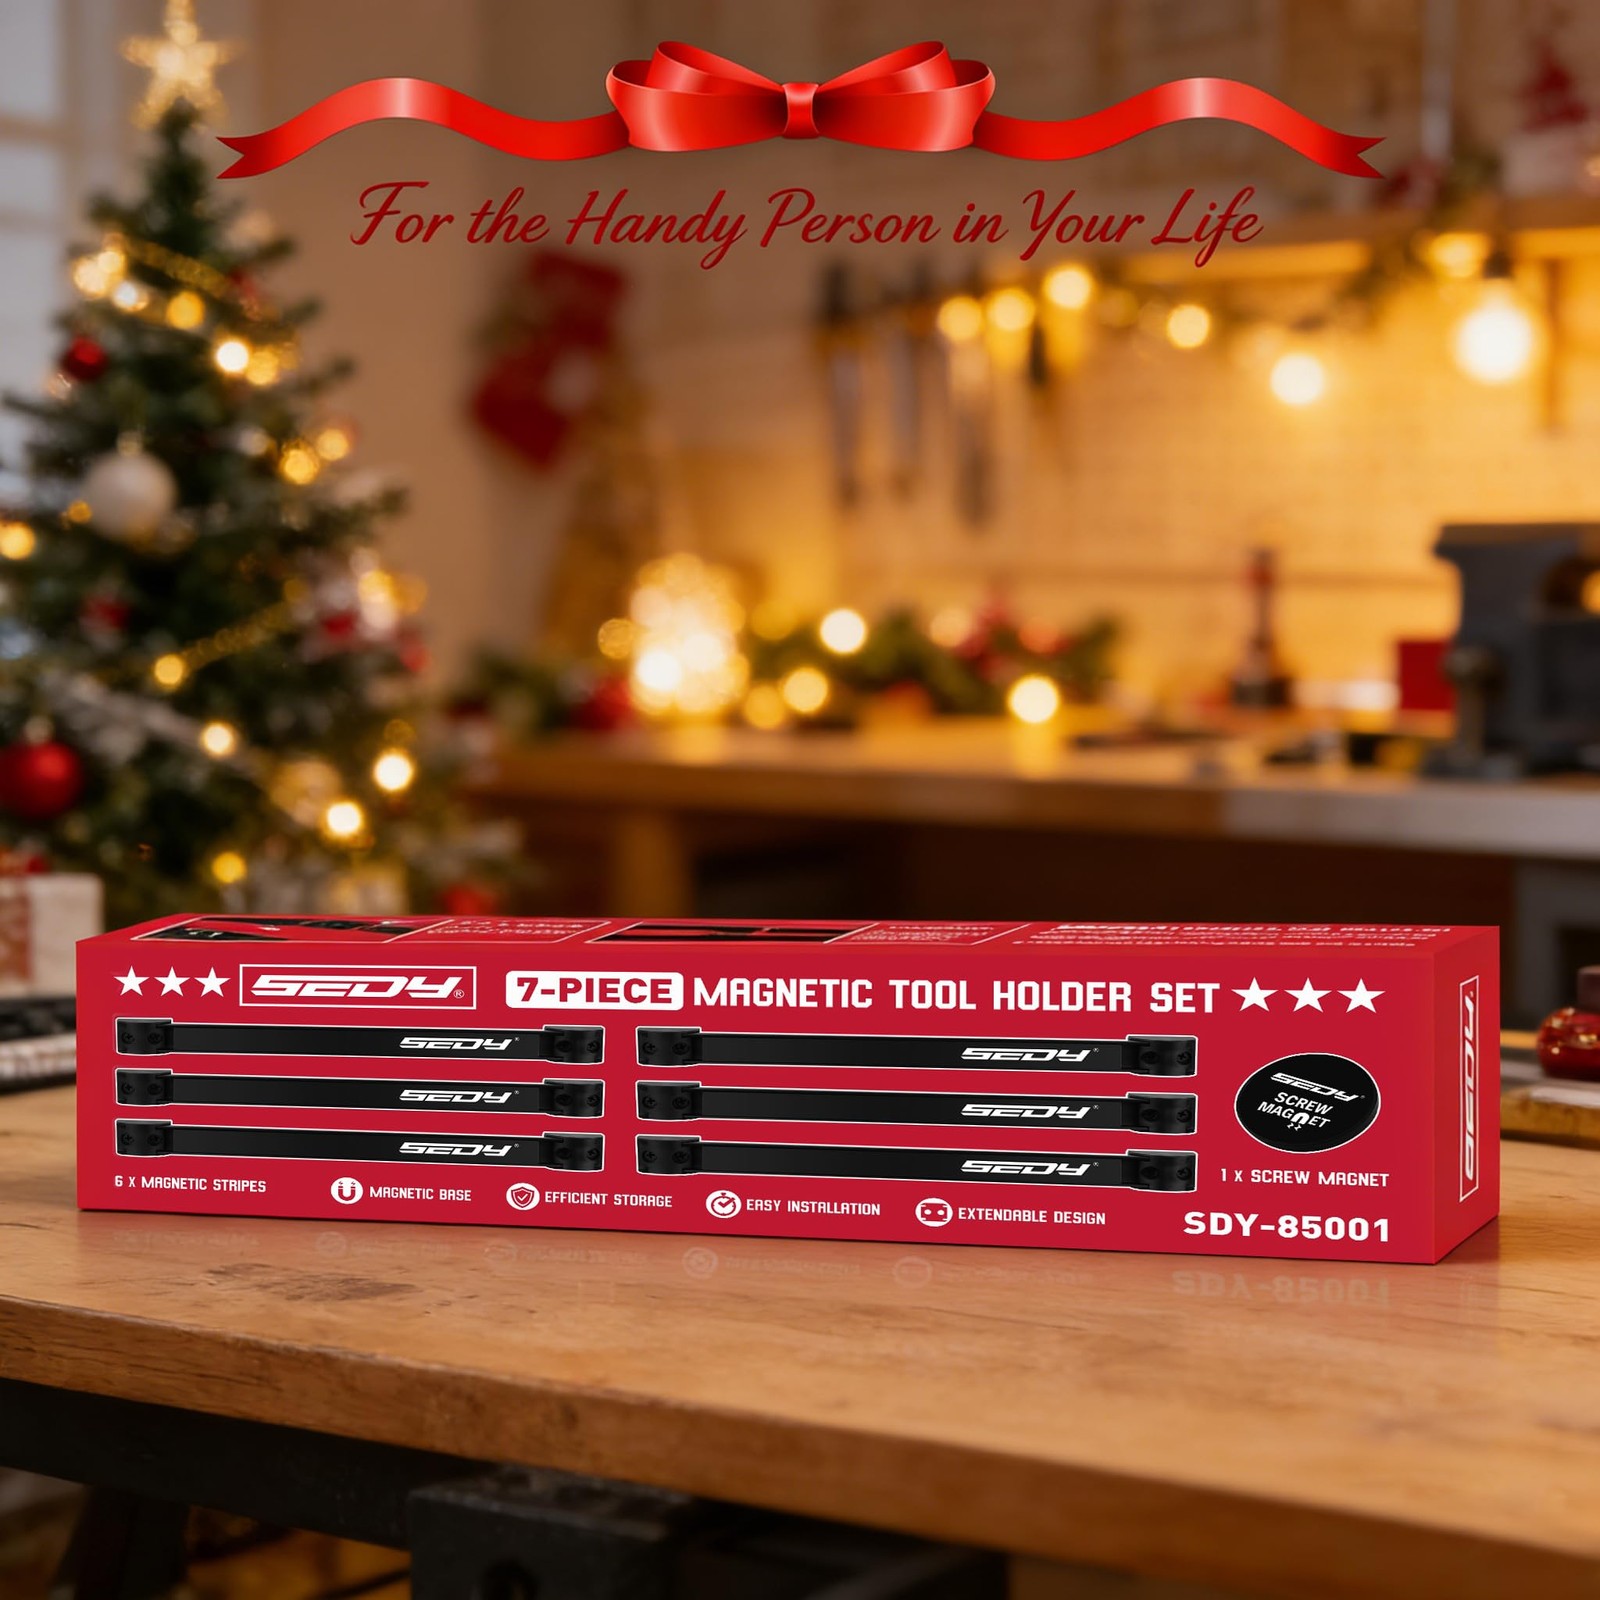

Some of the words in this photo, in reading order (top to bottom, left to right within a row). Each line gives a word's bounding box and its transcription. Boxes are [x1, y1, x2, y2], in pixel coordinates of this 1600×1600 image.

[517, 977, 672, 1004] 7-PIECE
[693, 977, 873, 1009] MAGNETIC
[888, 979, 977, 1010] TOOL
[993, 980, 1132, 1012] HOLDER
[1149, 982, 1221, 1014] SET
[1274, 1091, 1333, 1115] SCREW
[114, 1175, 124, 1187] 6
[141, 1175, 208, 1191] MAGNETIC
[212, 1178, 267, 1193] STRIPES
[1220, 1168, 1227, 1182] 1
[1250, 1169, 1311, 1185] SCREW
[1318, 1171, 1390, 1187] MAGNET
[369, 1186, 434, 1201] MAGNETIC
[439, 1188, 472, 1202] BASE
[544, 1191, 609, 1205] EFFICIENT
[613, 1193, 673, 1208] STORAGE
[746, 1198, 782, 1213] EASY
[787, 1200, 881, 1216] INSTALLATION
[958, 1207, 1048, 1224] EXTENDABLE
[1053, 1210, 1106, 1226] DESIGN
[1183, 1211, 1389, 1243] SDY-85001
